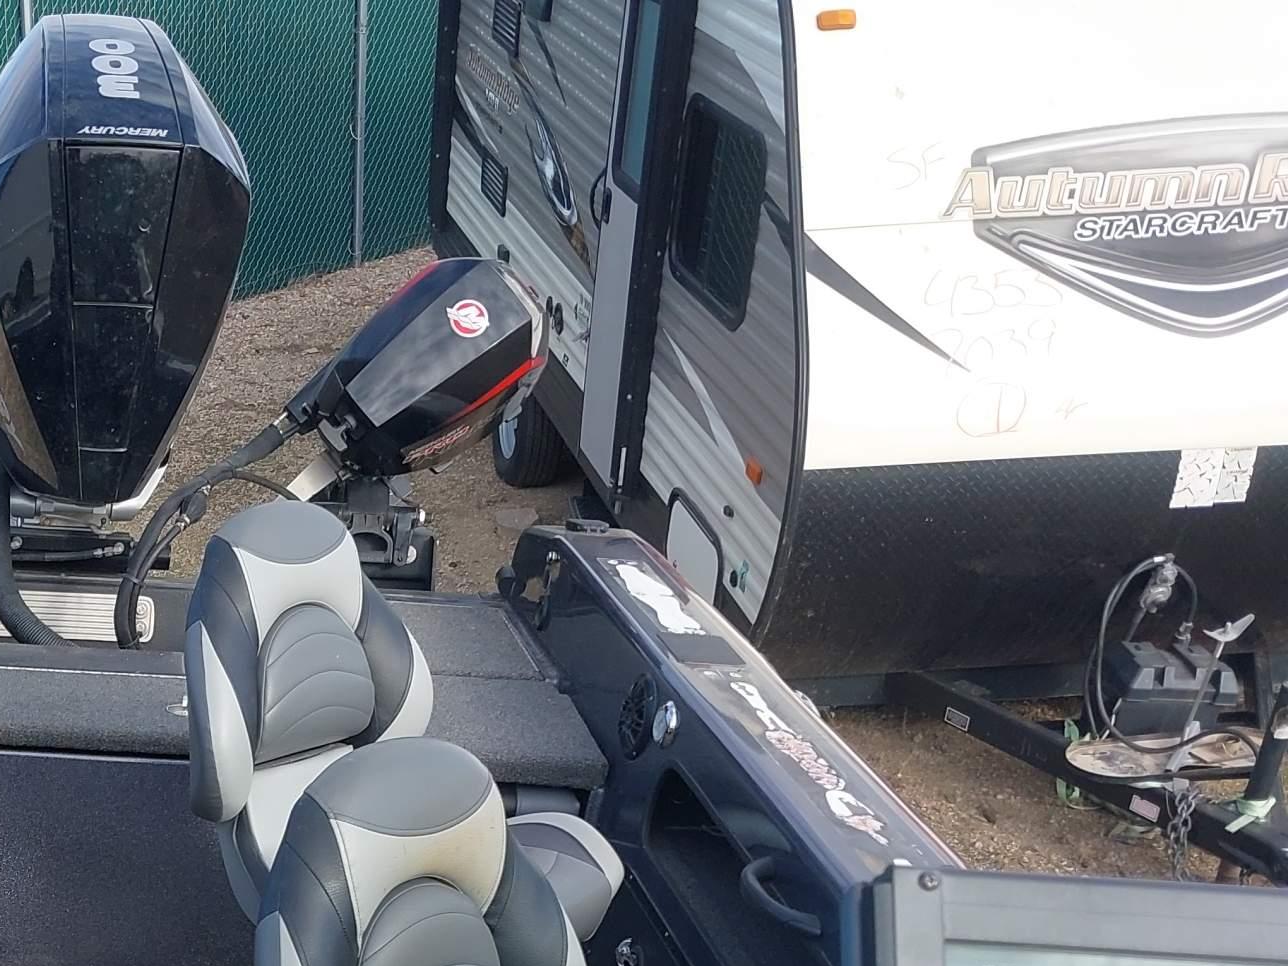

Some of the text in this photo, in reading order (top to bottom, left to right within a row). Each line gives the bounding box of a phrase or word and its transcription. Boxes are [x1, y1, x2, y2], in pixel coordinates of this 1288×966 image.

[88, 38, 140, 99] 300
[76, 125, 169, 138] MERCURY
[939, 161, 1250, 220] Autumn
[1074, 205, 1288, 241] STARCRAFT
